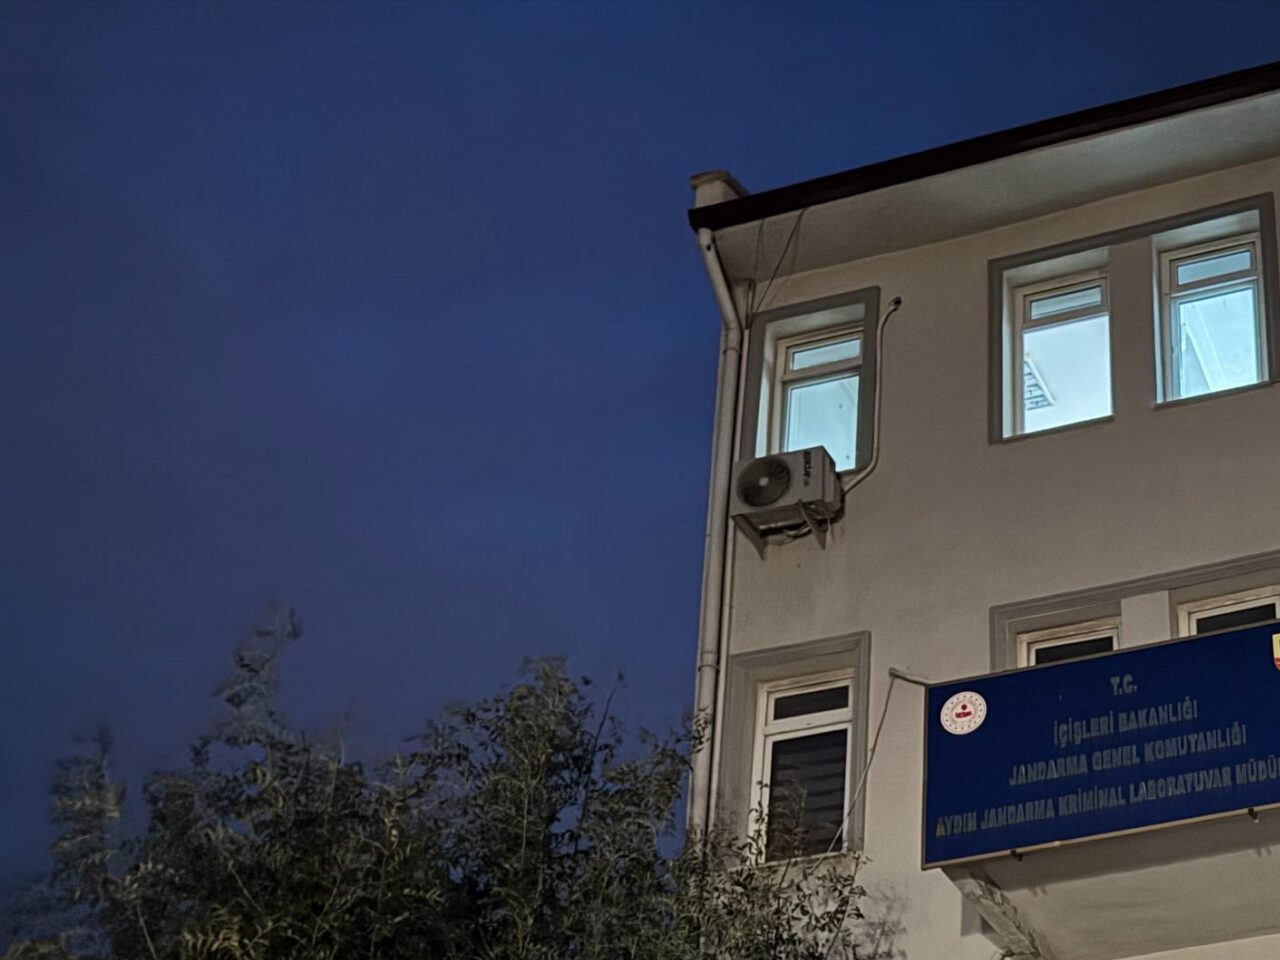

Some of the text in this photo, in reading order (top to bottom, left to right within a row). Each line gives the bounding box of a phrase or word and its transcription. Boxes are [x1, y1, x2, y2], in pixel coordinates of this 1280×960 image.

[1110, 674, 1138, 696] T.C.
[1053, 696, 1199, 748] İÇİŞLERİ BAKANLIĞI
[1009, 721, 1248, 786] JANDARMA GENEL KOMUTANLIĞI
[935, 811, 978, 837] AYDIN
[980, 798, 1056, 830] JANDARMA
[1058, 784, 1126, 816] KRİMİNAL
[1129, 766, 1233, 805] LABORATUVAR
